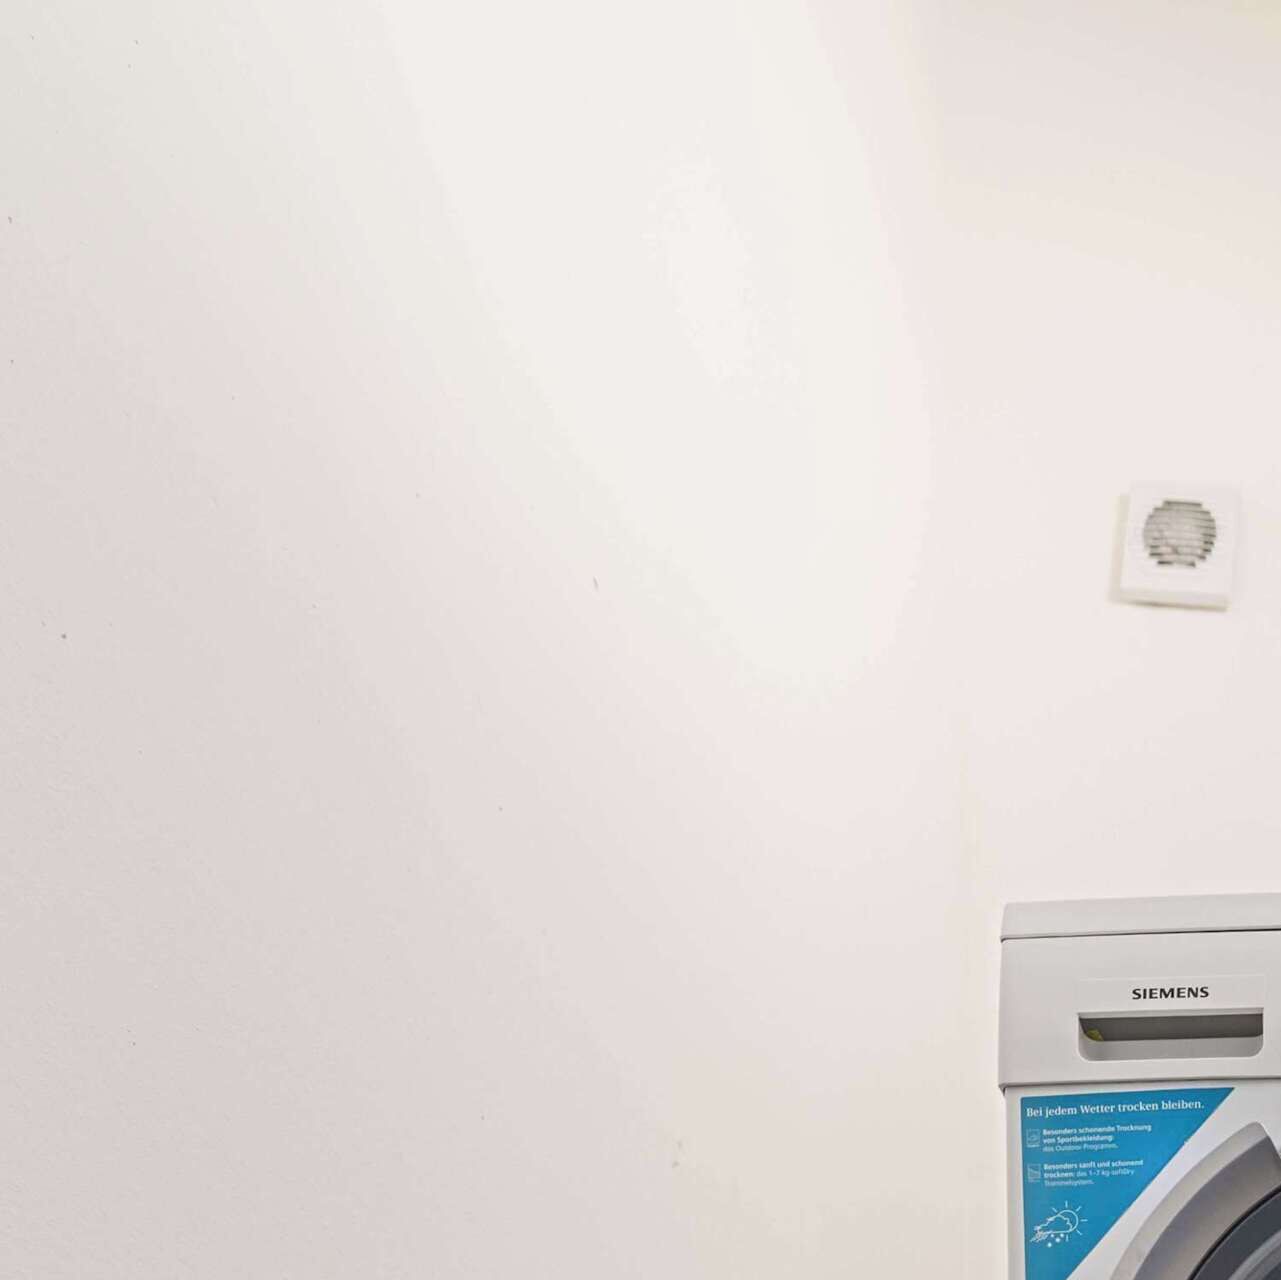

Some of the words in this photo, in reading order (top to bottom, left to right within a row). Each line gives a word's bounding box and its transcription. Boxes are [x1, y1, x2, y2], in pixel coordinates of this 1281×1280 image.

[1132, 986, 1209, 1000] SIEMENS
[1026, 1107, 1043, 1117] Bei
[1045, 1107, 1077, 1118] jedem
[1080, 1104, 1116, 1114] Wetter
[1117, 1101, 1159, 1112] trocken
[1161, 1099, 1205, 1110] bleiben.
[1043, 1128, 1077, 1136] Besonders
[1079, 1126, 1115, 1134] schonende
[1117, 1124, 1152, 1133] Trocknung
[1043, 1163, 1077, 1171] Besonders
[1079, 1161, 1096, 1170] sanft
[1097, 1160, 1110, 1168] und
